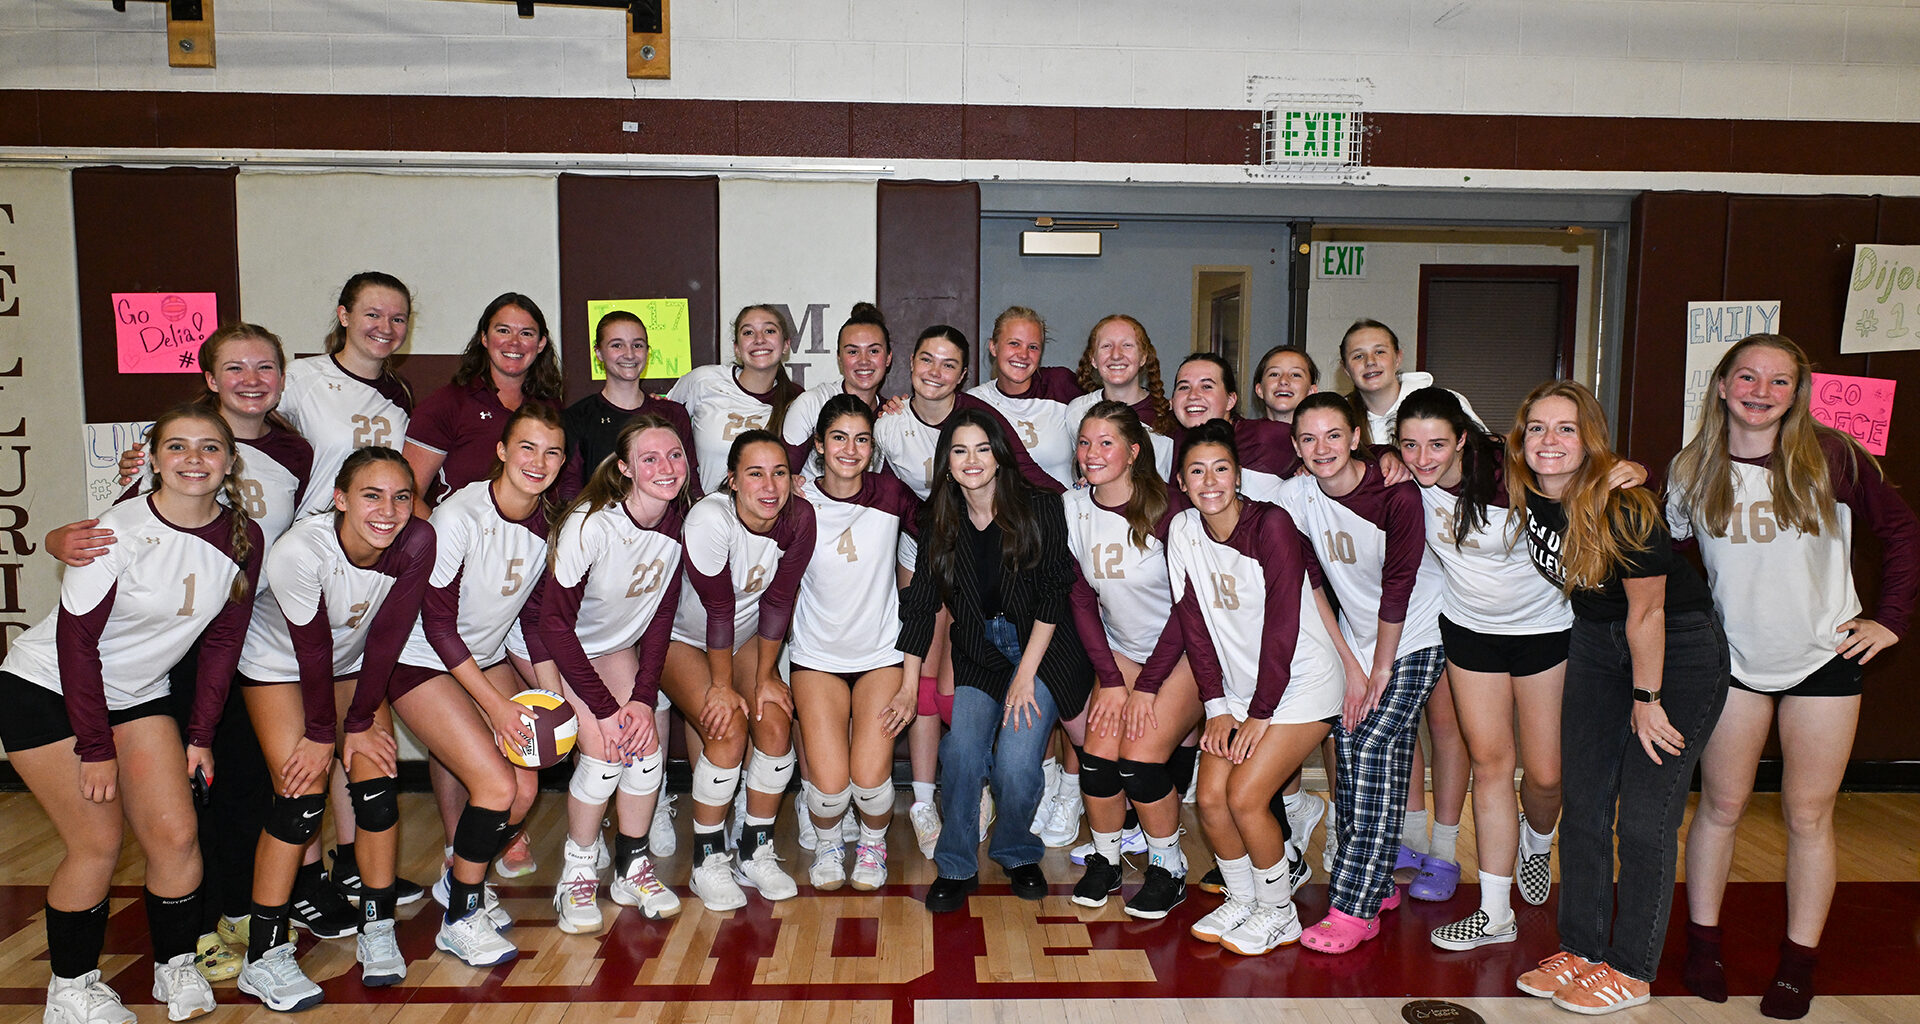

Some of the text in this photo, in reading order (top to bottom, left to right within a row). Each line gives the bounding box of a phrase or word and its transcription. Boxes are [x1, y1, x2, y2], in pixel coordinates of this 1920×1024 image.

[1284, 111, 1346, 157] EXIT
[1323, 246, 1365, 276] EXIT
[1853, 247, 1920, 304] Dijo
[118, 299, 149, 325] Go
[1690, 305, 1779, 344] EMILY
[1856, 302, 1920, 338] #1
[140, 312, 204, 353] Delia!
[1820, 380, 1862, 406] GO
[351, 414, 392, 449] 22
[1730, 500, 1777, 544] 16
[837, 527, 858, 563] 4
[1092, 543, 1125, 580] 12
[1324, 529, 1357, 565] 10
[176, 573, 196, 617] 1
[500, 558, 524, 597] 5
[625, 558, 665, 599] 23
[744, 564, 766, 593] 6
